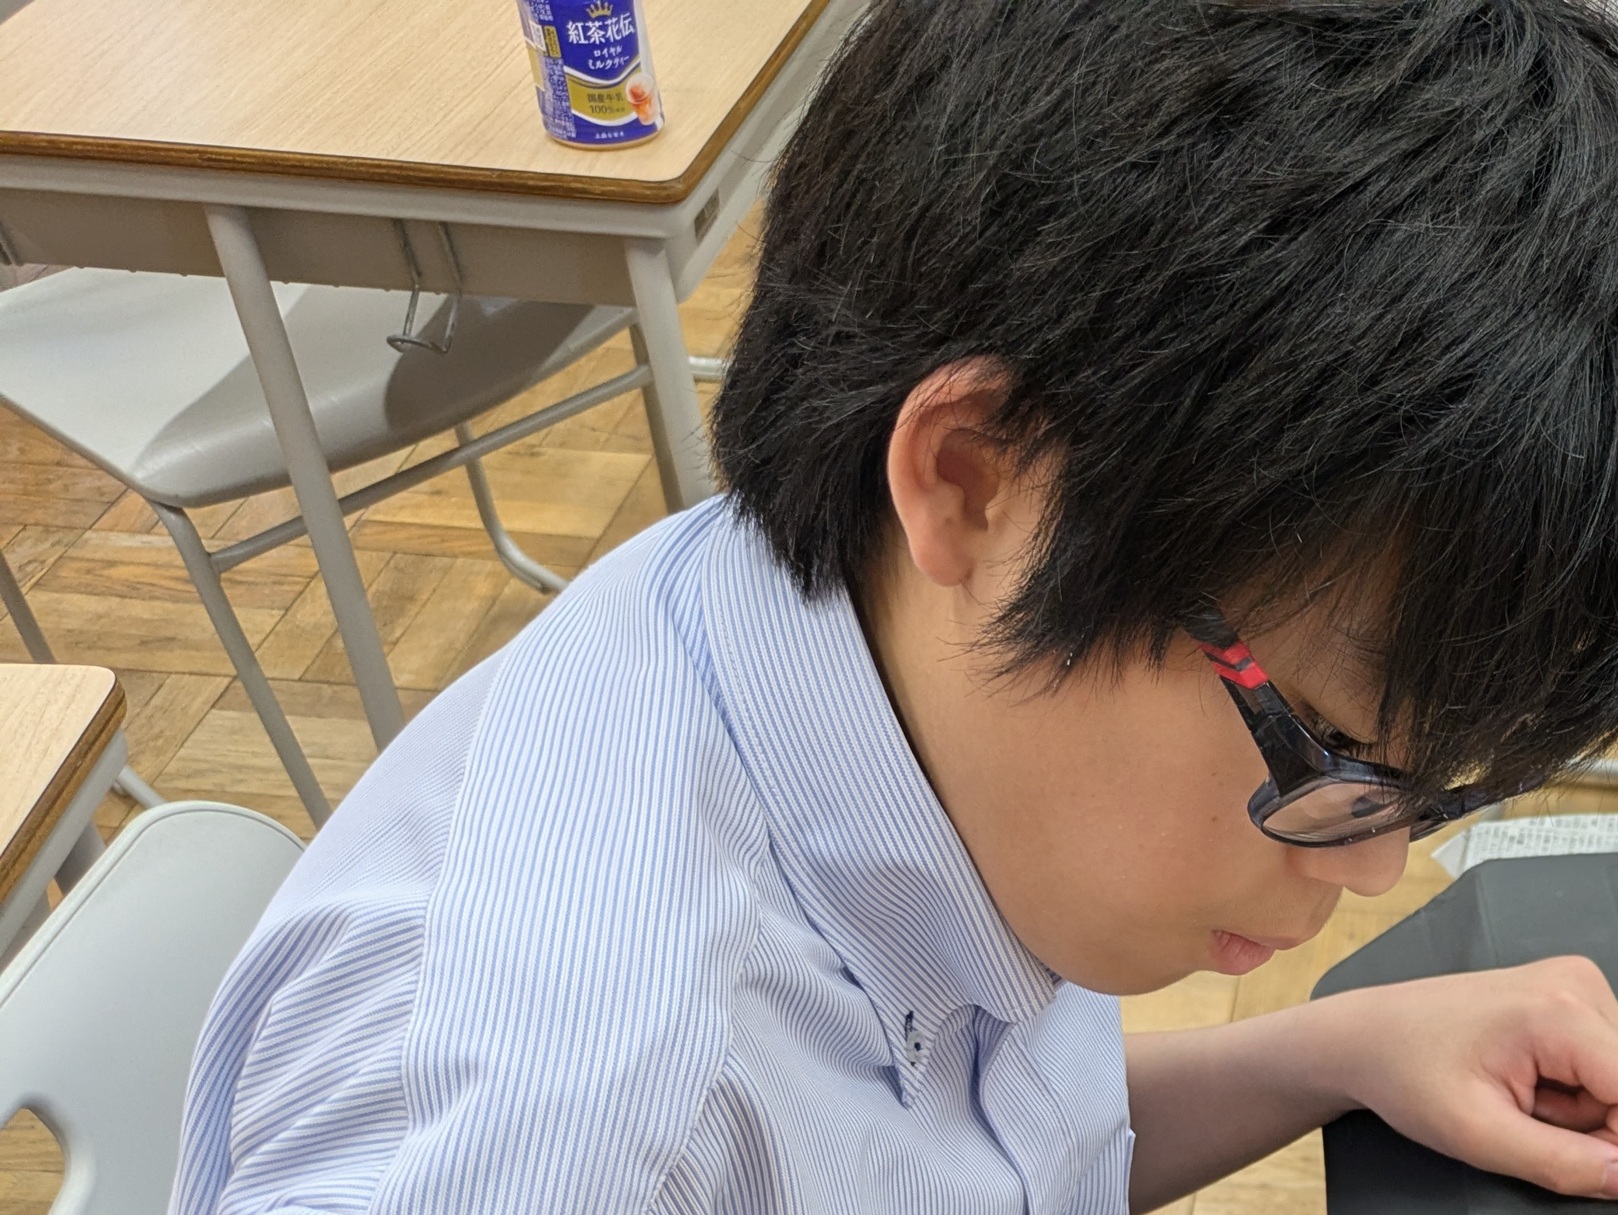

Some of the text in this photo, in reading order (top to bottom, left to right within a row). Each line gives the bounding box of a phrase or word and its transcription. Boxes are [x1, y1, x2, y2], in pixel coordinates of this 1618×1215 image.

[566, 12, 635, 45] 紅茶花伝
[594, 45, 623, 57] ロイヤル
[588, 56, 630, 70] ミルクティー
